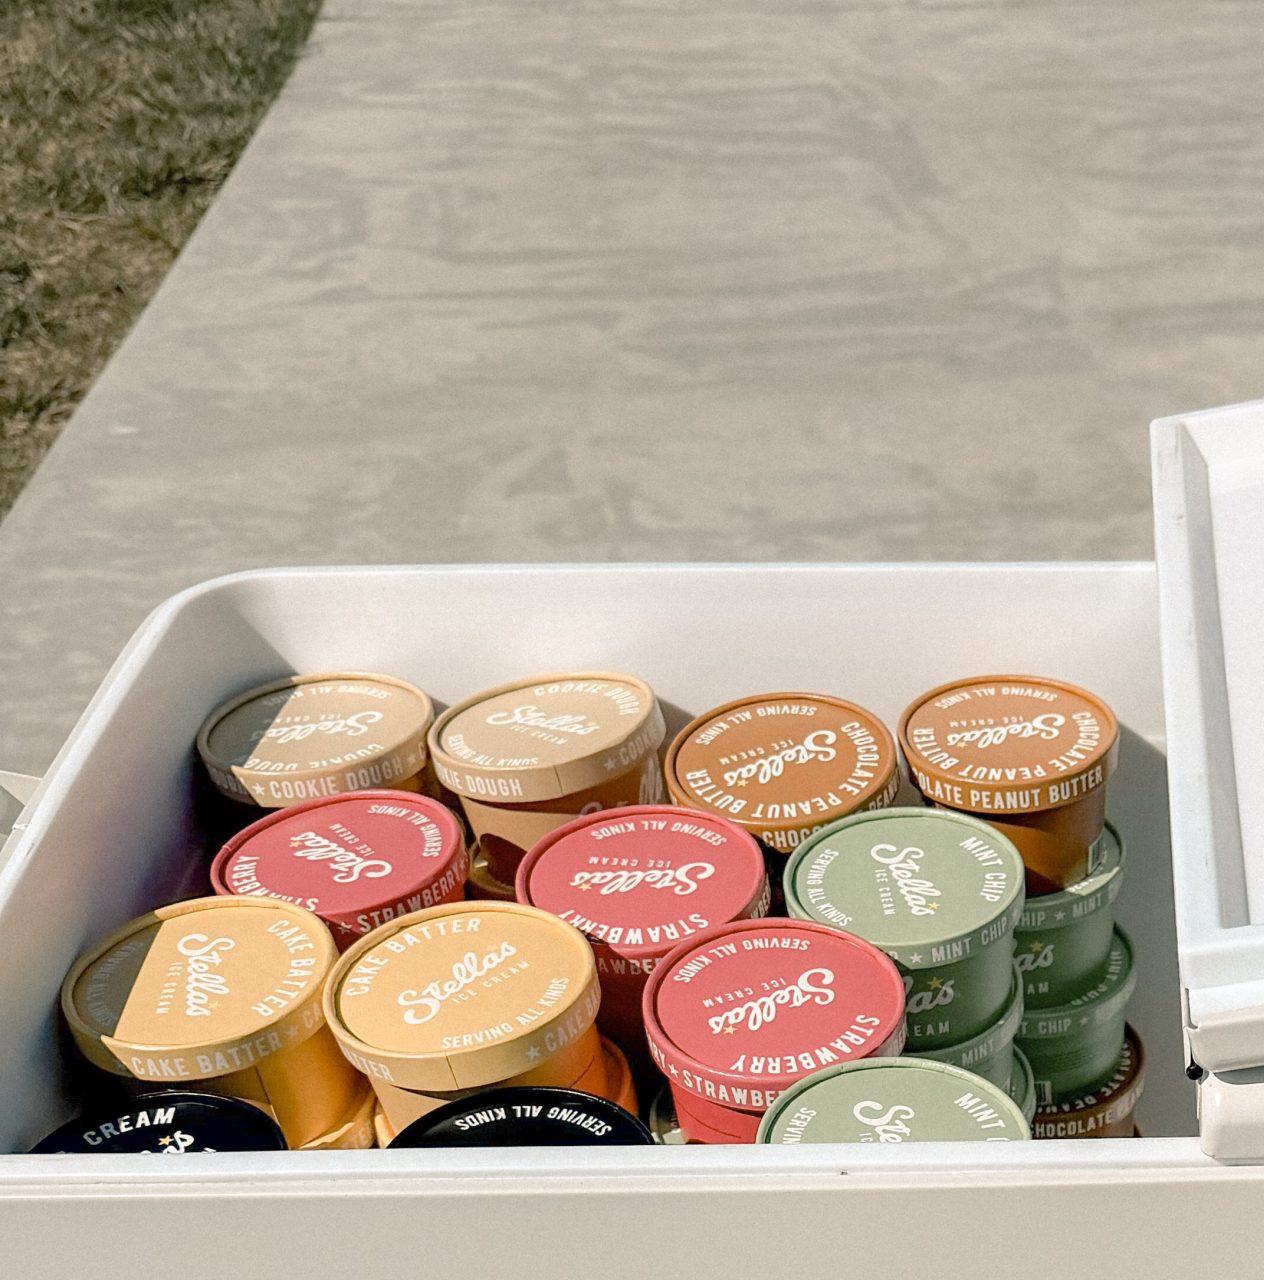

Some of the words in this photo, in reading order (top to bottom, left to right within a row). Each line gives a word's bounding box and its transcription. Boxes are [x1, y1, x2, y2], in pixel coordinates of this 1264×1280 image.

[534, 682, 608, 696] COOKIE
[604, 686, 641, 716] DOUGH
[935, 694, 972, 710] KINDS
[972, 687, 996, 698] ALL
[1001, 686, 1058, 701] SERVING
[485, 704, 601, 736] Stella's
[728, 711, 753, 726] ALL
[756, 704, 818, 718] SERVING
[949, 717, 995, 729] CREAM
[1003, 715, 1024, 724] ICE
[695, 722, 730, 747] KINDS
[770, 739, 795, 751] ICE
[946, 713, 1066, 749] Stella's
[1048, 711, 1101, 772] CHOCOLATE
[471, 751, 492, 768] ALL
[497, 757, 538, 768] KINDS
[719, 746, 766, 767] CREAM
[723, 729, 838, 788] Stella's
[838, 721, 880, 797] CHOCOLATE
[913, 727, 961, 771] BUTTER
[269, 775, 340, 799] COOKIE
[346, 754, 404, 791] DOUGH
[464, 774, 524, 797] DOUGH
[958, 763, 1047, 781] PEANUT
[685, 768, 748, 815] BUTTER
[969, 788, 1041, 810] PEANUT
[1049, 765, 1103, 804] BUTTER
[367, 804, 410, 819] KINDS
[751, 792, 843, 819] PEANUT
[329, 822, 361, 845] CREAM
[406, 811, 431, 829] ALL
[591, 821, 635, 841] KINDS
[642, 820, 667, 831] ALL
[671, 821, 727, 847] SERVING
[355, 843, 375, 857] ICE
[421, 823, 444, 859] SERVING
[959, 836, 1004, 868] MINT
[290, 831, 393, 884] Stella's
[588, 855, 638, 867] CREAM
[649, 859, 671, 868] ICE
[806, 848, 839, 886] SERVING
[569, 861, 716, 896] Stella's
[870, 843, 942, 917] Stella's
[875, 869, 889, 883] ICE
[980, 872, 1007, 903] CHIP
[807, 887, 826, 905] ALL
[878, 886, 897, 916] CREAM
[1072, 892, 1102, 918] MINT
[816, 902, 853, 928] KINDS
[267, 919, 315, 954] CAKE
[742, 937, 812, 951] SERVING
[931, 936, 973, 963] MINT
[980, 917, 1008, 945] CHIP
[345, 956, 390, 997] CAKE
[384, 917, 482, 954] BATTER
[708, 942, 738, 960] ALL
[168, 961, 183, 976] ICE
[176, 932, 236, 1018] Stella's
[451, 988, 478, 1004] ICE
[484, 959, 531, 988] CREAM
[673, 956, 713, 984] KINDS
[250, 957, 316, 1018] BATTER
[396, 941, 518, 1025] Stella's
[702, 986, 754, 1008] CREAM
[761, 977, 788, 991] ICE
[156, 981, 175, 1015] CREAM
[707, 967, 836, 1036] Stella's
[441, 1023, 514, 1050] SERVING
[517, 1007, 545, 1026] ALL
[537, 976, 570, 1009] KINDS
[1038, 1018, 1072, 1035] CHIP
[543, 1011, 586, 1052] CAKE
[729, 1013, 881, 1074] STRAWBERRY
[131, 1056, 190, 1078] CAKE
[196, 1033, 282, 1074] BATTER
[962, 1038, 994, 1067] MINT
[455, 1107, 506, 1131] KINDS
[512, 1105, 543, 1118] ALL
[547, 1106, 612, 1137] SERVING
[953, 1092, 1006, 1130] MINT
[82, 1106, 176, 1146] CREAM
